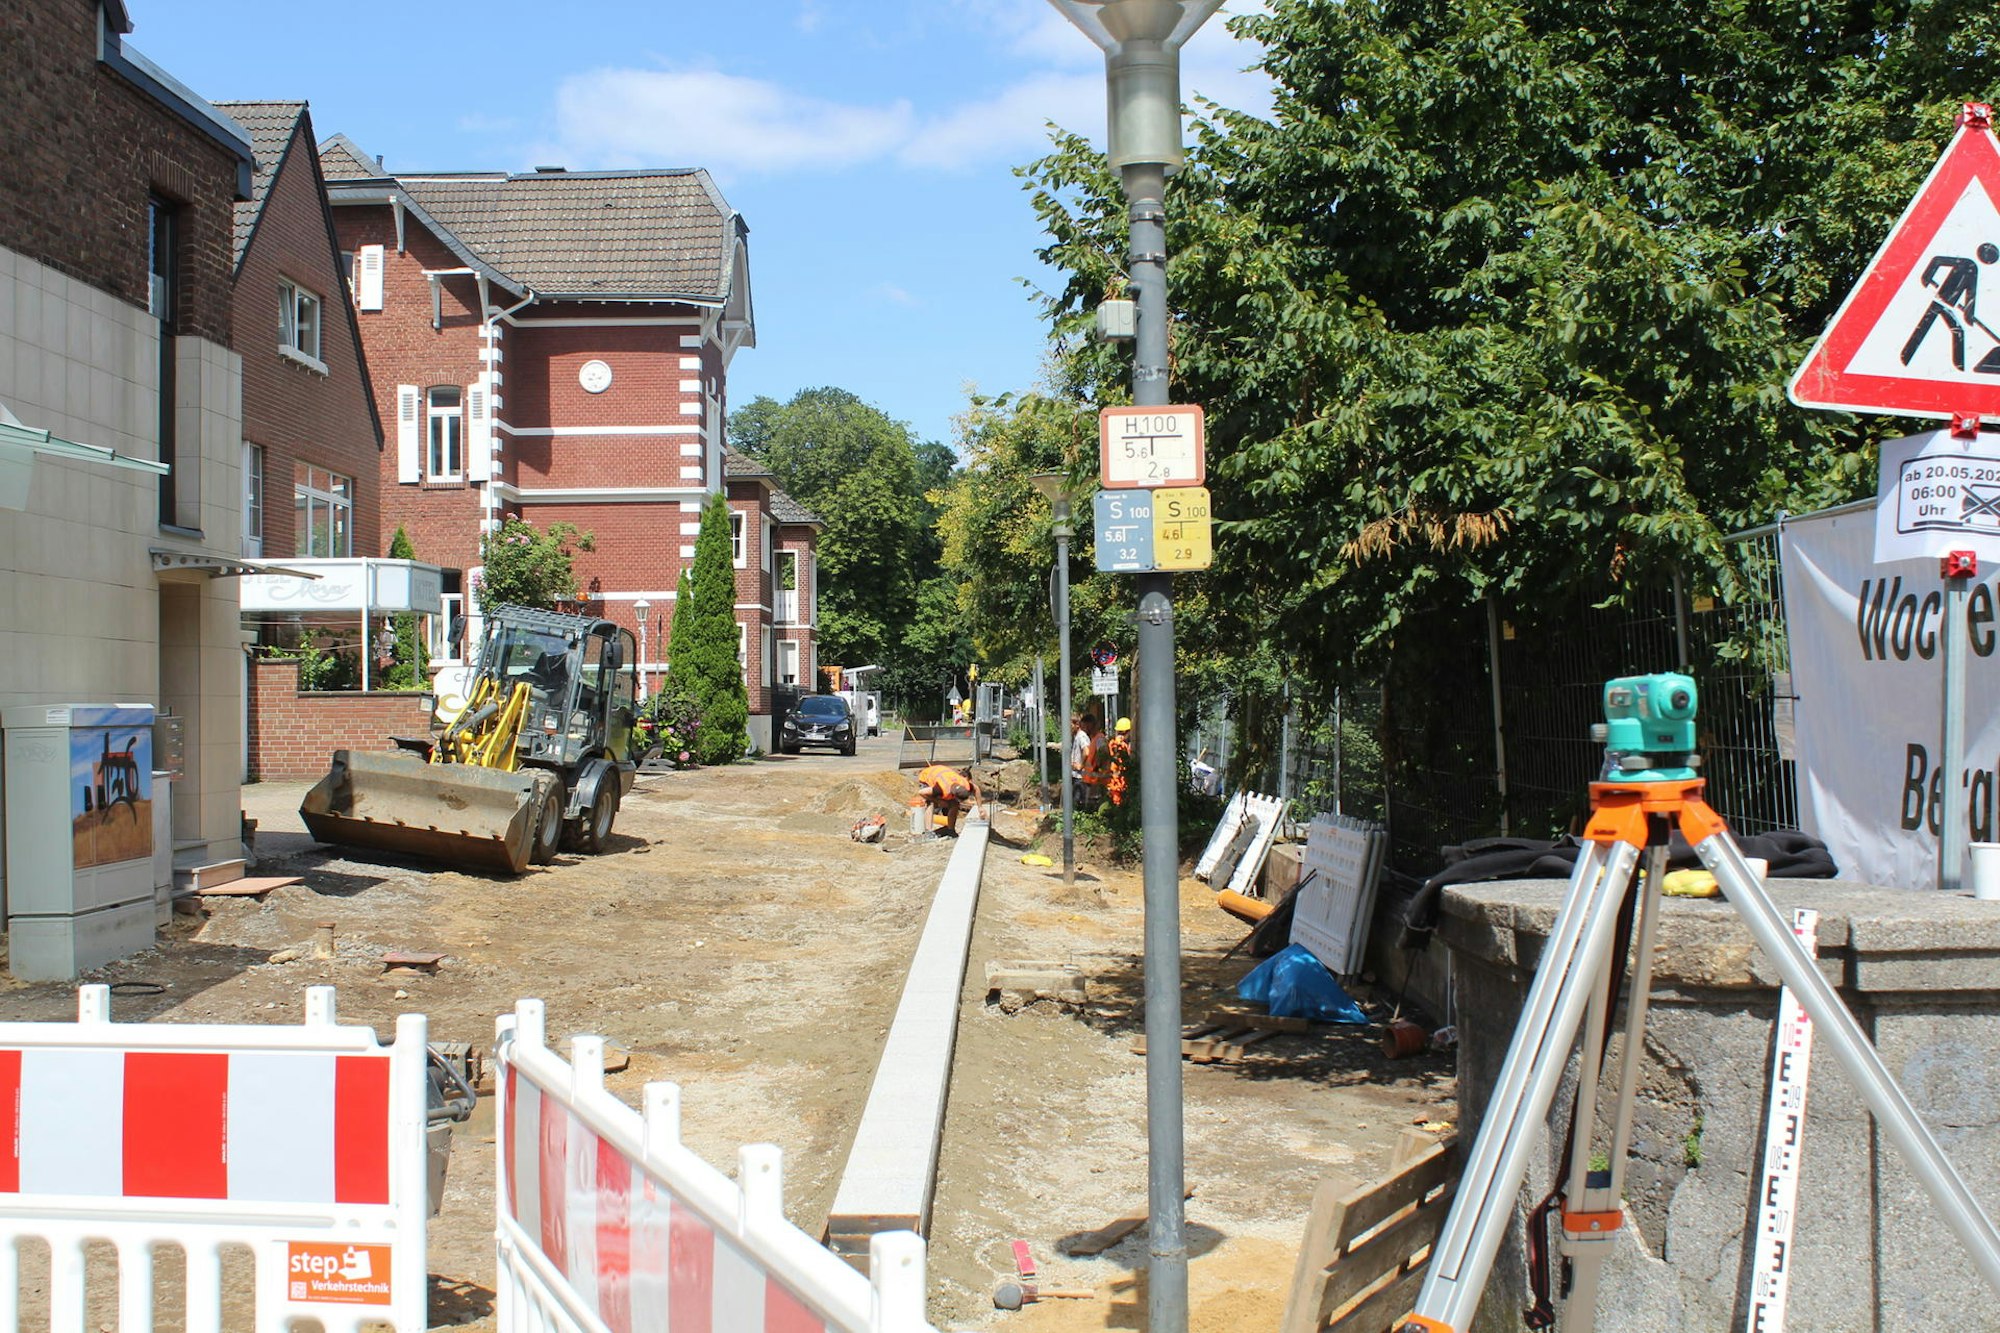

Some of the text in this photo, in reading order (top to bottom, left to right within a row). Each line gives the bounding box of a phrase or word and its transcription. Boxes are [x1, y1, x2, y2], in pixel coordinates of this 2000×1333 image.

[1125, 441, 1148, 459] 5.6
[1148, 461, 1171, 478] 2.8
[1905, 470, 1921, 482] ab
[1911, 485, 1956, 500] 06:00
[1110, 501, 1150, 519] S 100
[1168, 501, 1207, 517] S 100
[1919, 504, 1947, 516] Uhr
[1105, 530, 1123, 543] 5.6
[1162, 529, 1180, 541] 4.6
[1119, 548, 1137, 560] 3.2
[1175, 548, 1192, 560] 2.9
[1857, 576, 2000, 661] Woce
[290, 1252, 339, 1280] step
[311, 1280, 389, 1293] Verkehrstechnik
